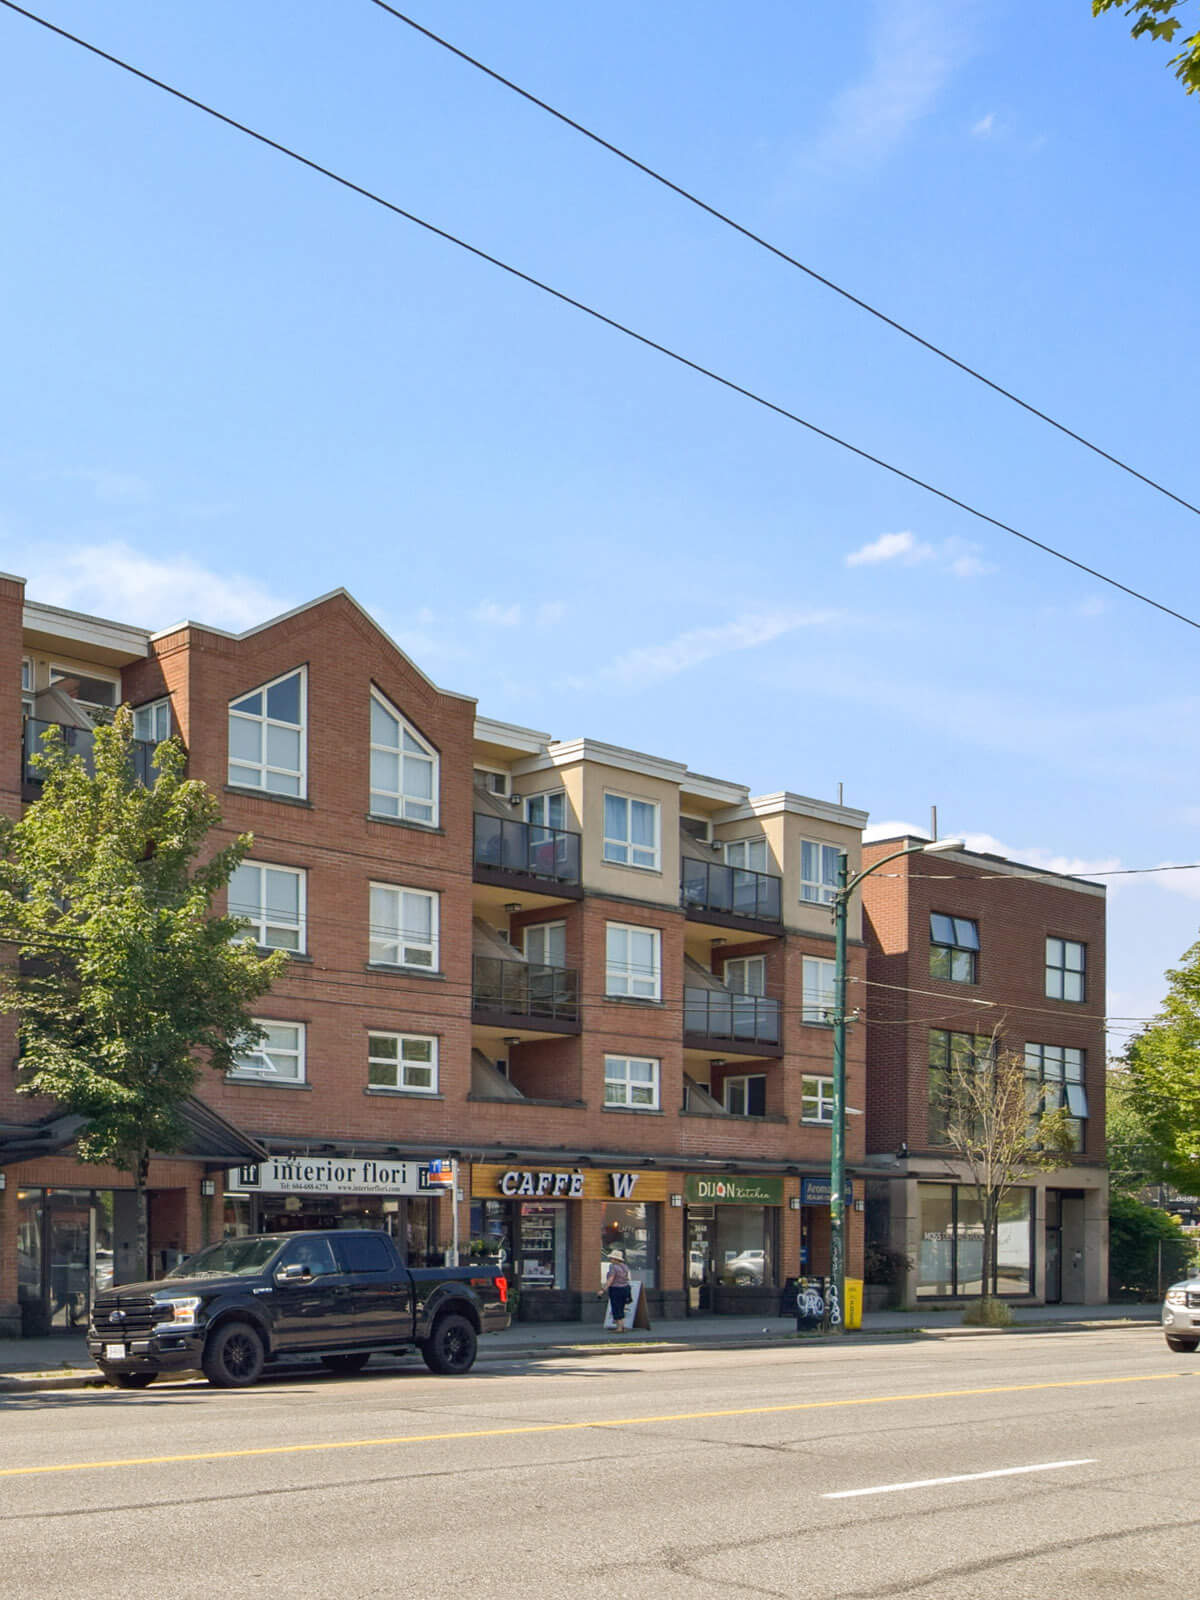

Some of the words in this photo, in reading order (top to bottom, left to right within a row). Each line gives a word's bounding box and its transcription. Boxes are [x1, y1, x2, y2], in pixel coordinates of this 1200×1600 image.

[243, 1164, 257, 1181] if
[273, 1159, 356, 1182] interior
[363, 1162, 408, 1183] flori
[502, 1168, 584, 1197] CAFFÈ
[612, 1173, 639, 1198] W
[699, 1182, 735, 1197] DIJON
[736, 1187, 770, 1199] Kitchen
